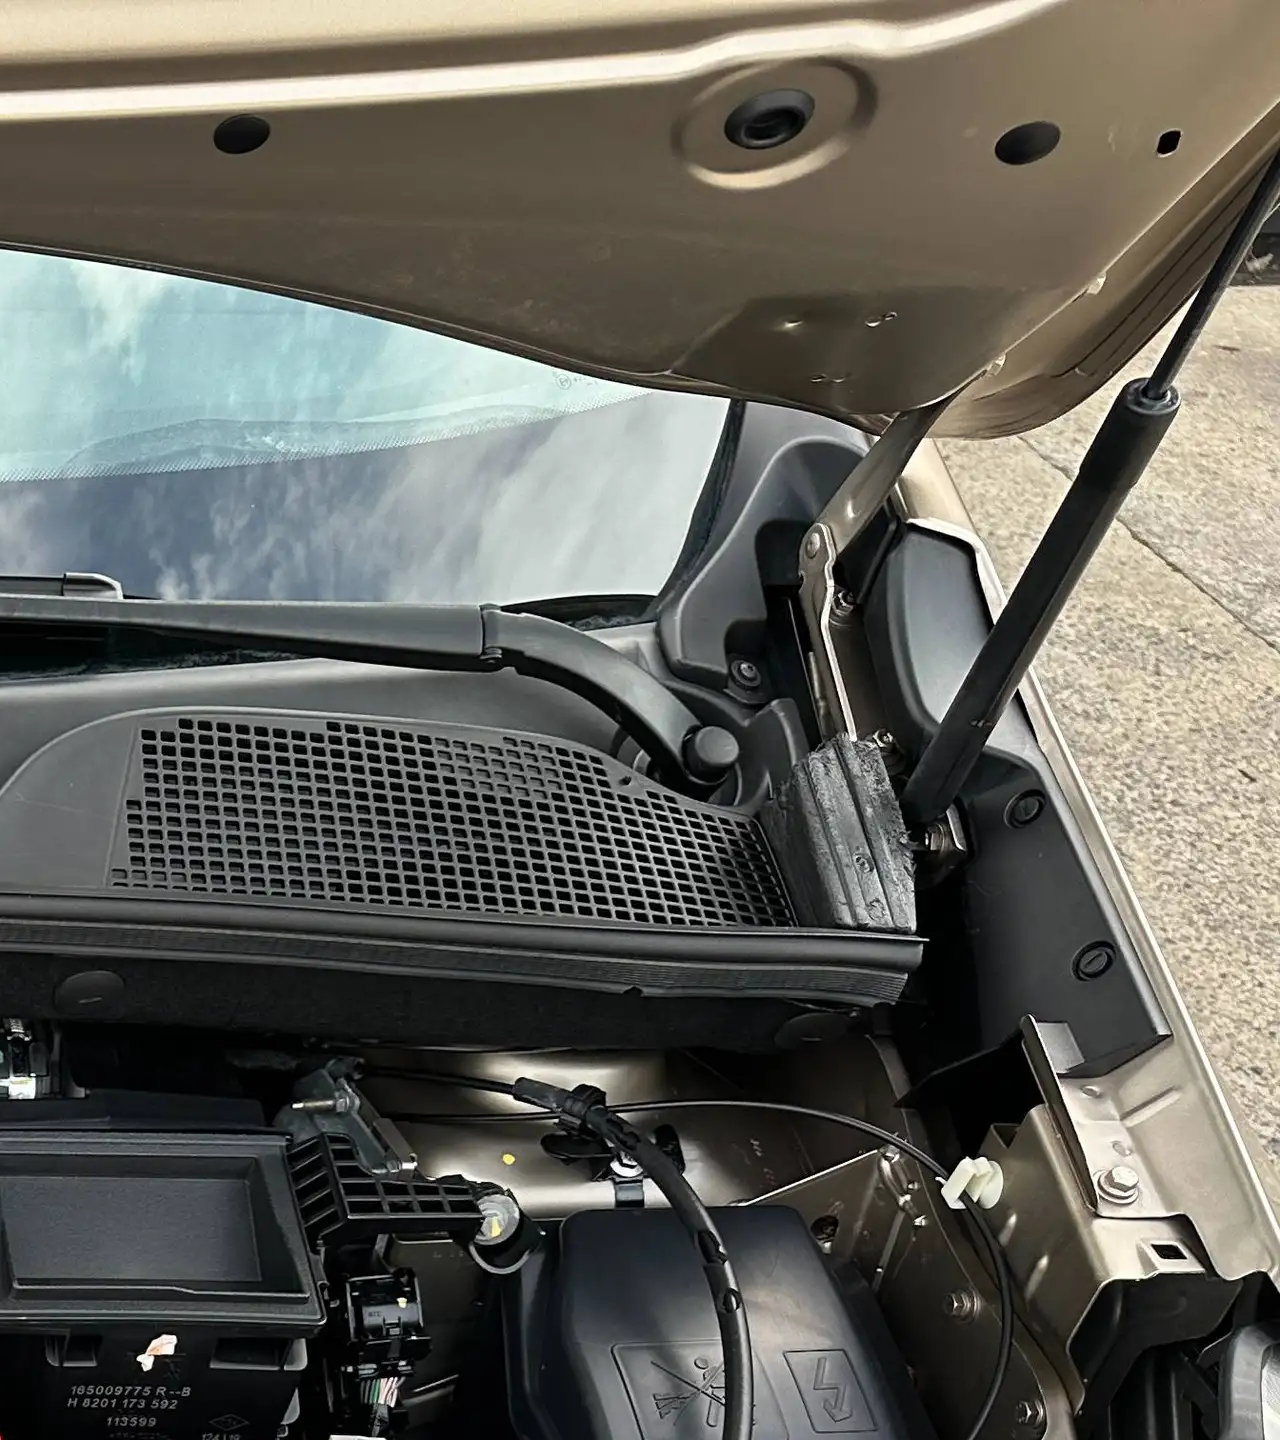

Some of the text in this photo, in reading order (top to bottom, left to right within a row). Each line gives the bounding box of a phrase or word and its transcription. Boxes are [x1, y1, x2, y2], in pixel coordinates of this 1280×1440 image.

[67, 1398, 178, 1410] H 8201 173 592
